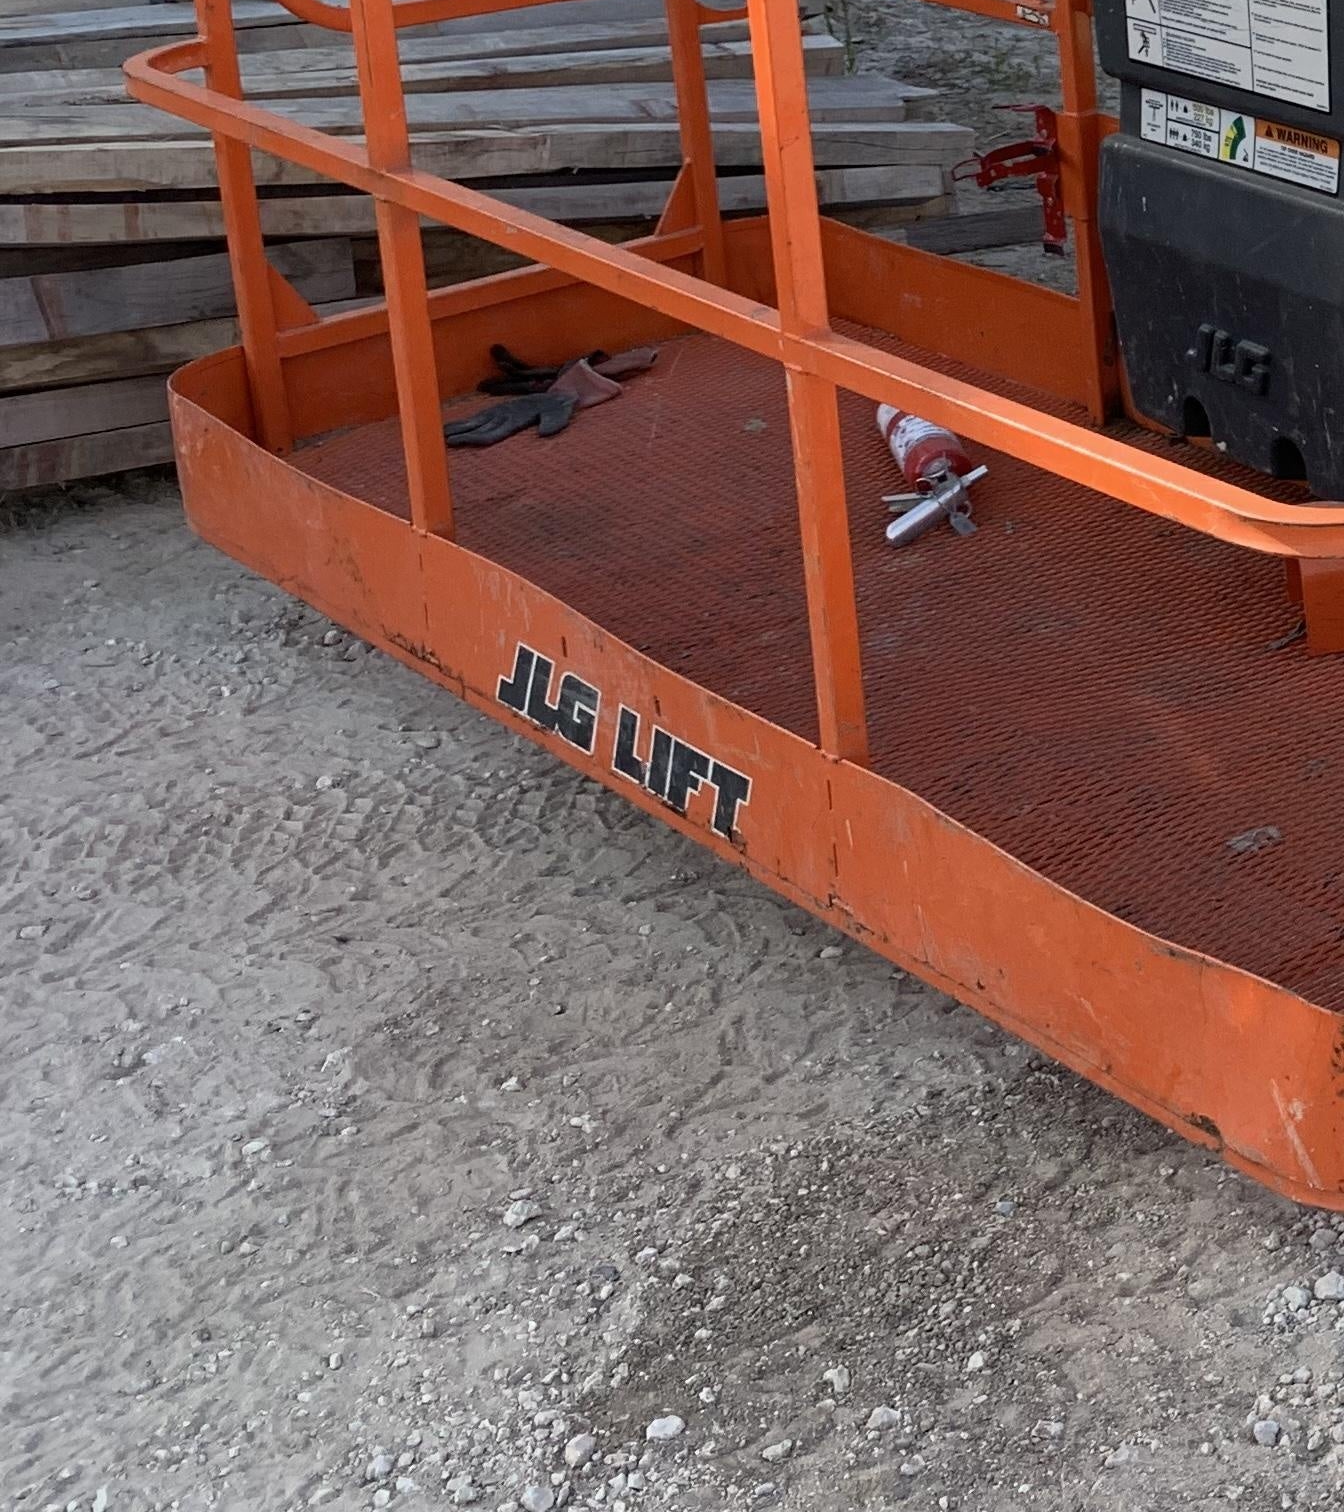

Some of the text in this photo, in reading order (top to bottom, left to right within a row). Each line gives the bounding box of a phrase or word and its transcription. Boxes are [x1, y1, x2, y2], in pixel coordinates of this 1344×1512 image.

[1276, 127, 1328, 154] WARNING
[496, 641, 752, 839] JLG LIFT
